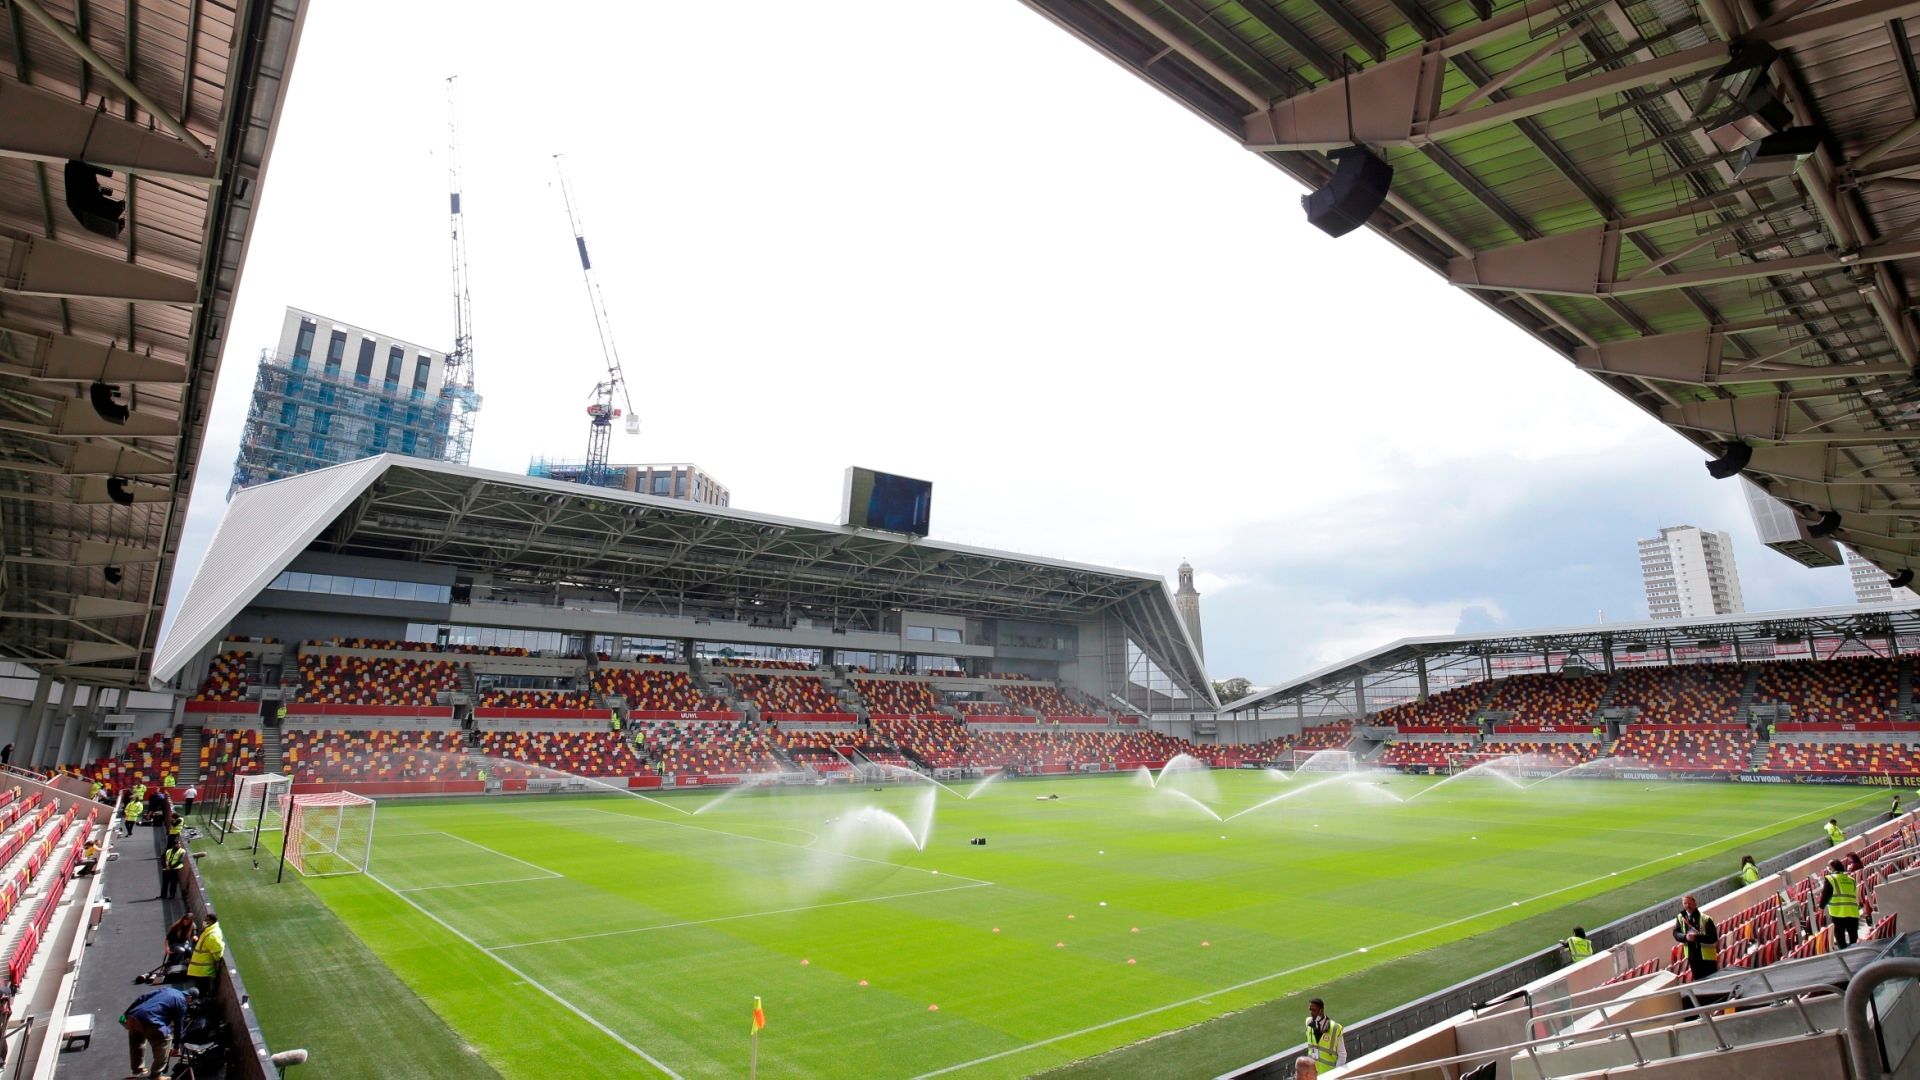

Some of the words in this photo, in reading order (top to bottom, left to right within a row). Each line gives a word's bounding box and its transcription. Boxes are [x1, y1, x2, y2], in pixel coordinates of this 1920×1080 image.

[1623, 772, 1658, 780] HOLLYWOOD
[1740, 775, 1781, 783] HOLLYWOOD
[1862, 775, 1901, 785] GAMBLE
